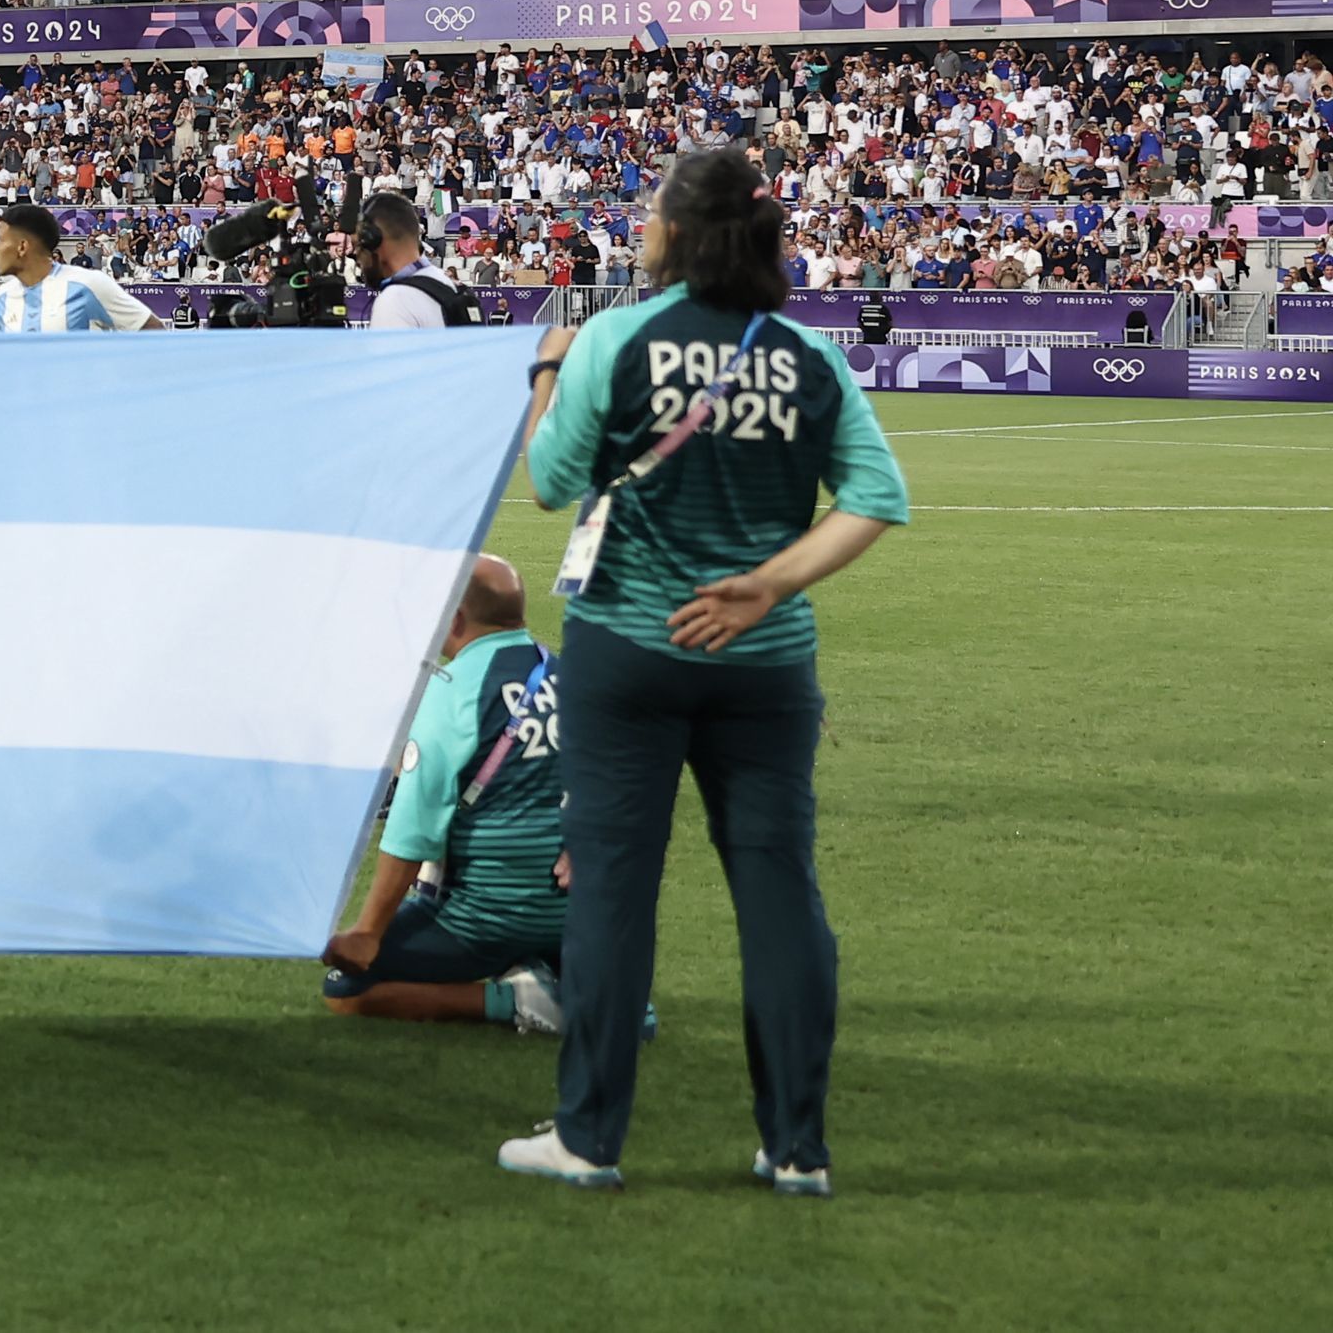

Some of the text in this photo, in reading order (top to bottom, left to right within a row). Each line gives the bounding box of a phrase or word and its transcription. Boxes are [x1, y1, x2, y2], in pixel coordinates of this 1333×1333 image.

[25, 19, 102, 44] 2024
[1164, 213, 1211, 230] 202
[1266, 366, 1321, 382] 2024
